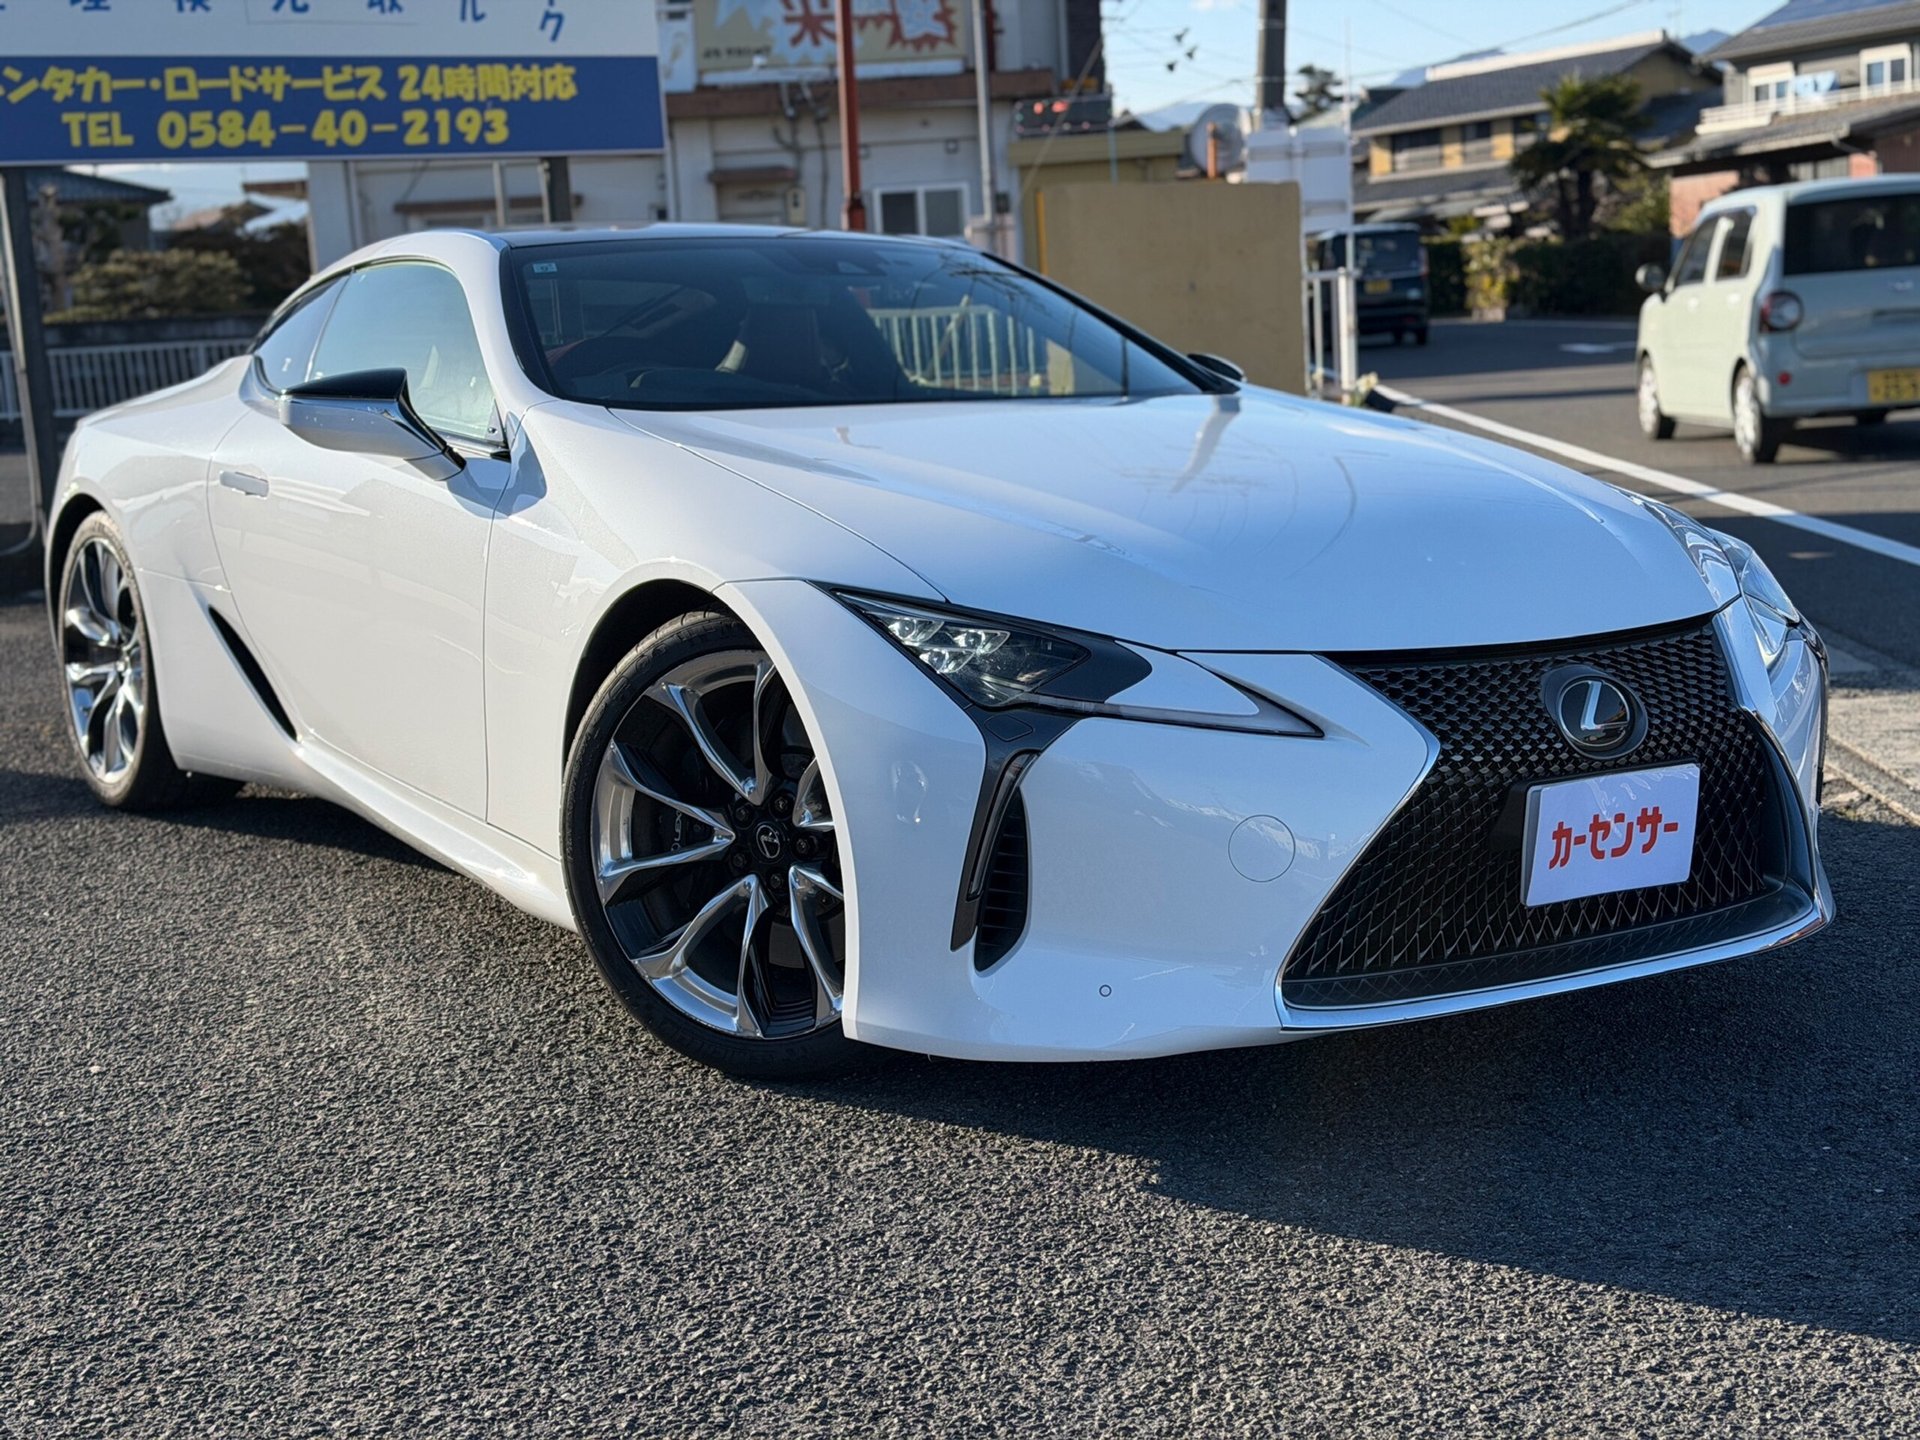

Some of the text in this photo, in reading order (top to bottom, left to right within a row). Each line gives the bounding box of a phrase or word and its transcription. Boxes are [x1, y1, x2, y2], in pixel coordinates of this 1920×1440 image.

[0, 64, 577, 103] ンタカー・ロードサービス 24時間対応
[61, 109, 509, 148] TEL 0584-40-2193
[1549, 806, 1679, 870] カーセンサー
